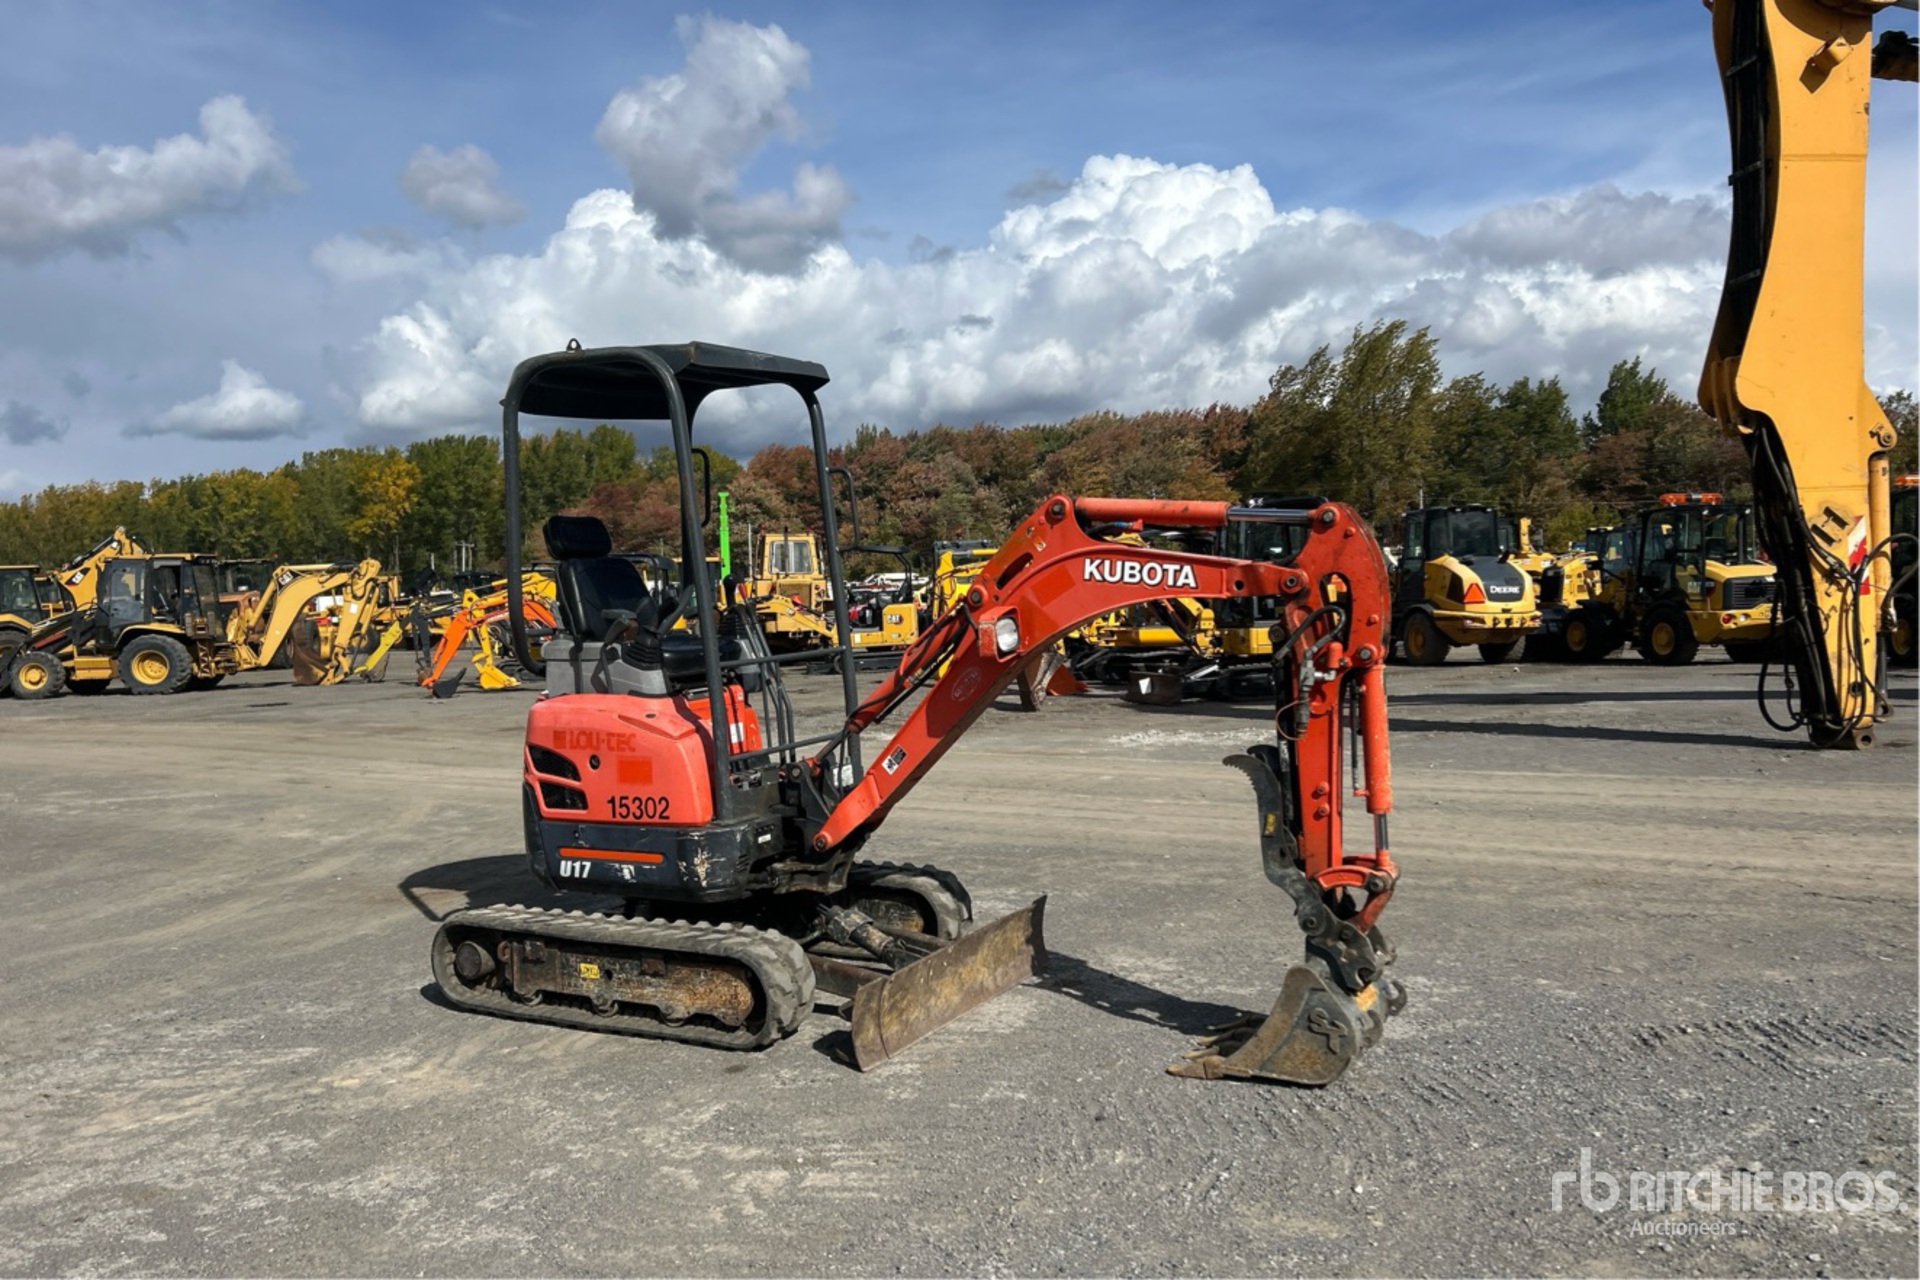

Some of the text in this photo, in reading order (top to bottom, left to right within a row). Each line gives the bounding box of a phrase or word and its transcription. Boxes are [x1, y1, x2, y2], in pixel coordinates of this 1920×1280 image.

[278, 571, 294, 586] CAT
[1084, 558, 1197, 588] KUBOTA
[1490, 586, 1520, 595] DEERE
[886, 614, 899, 624] CAT
[606, 796, 670, 820] 15302
[559, 860, 592, 879] U17
